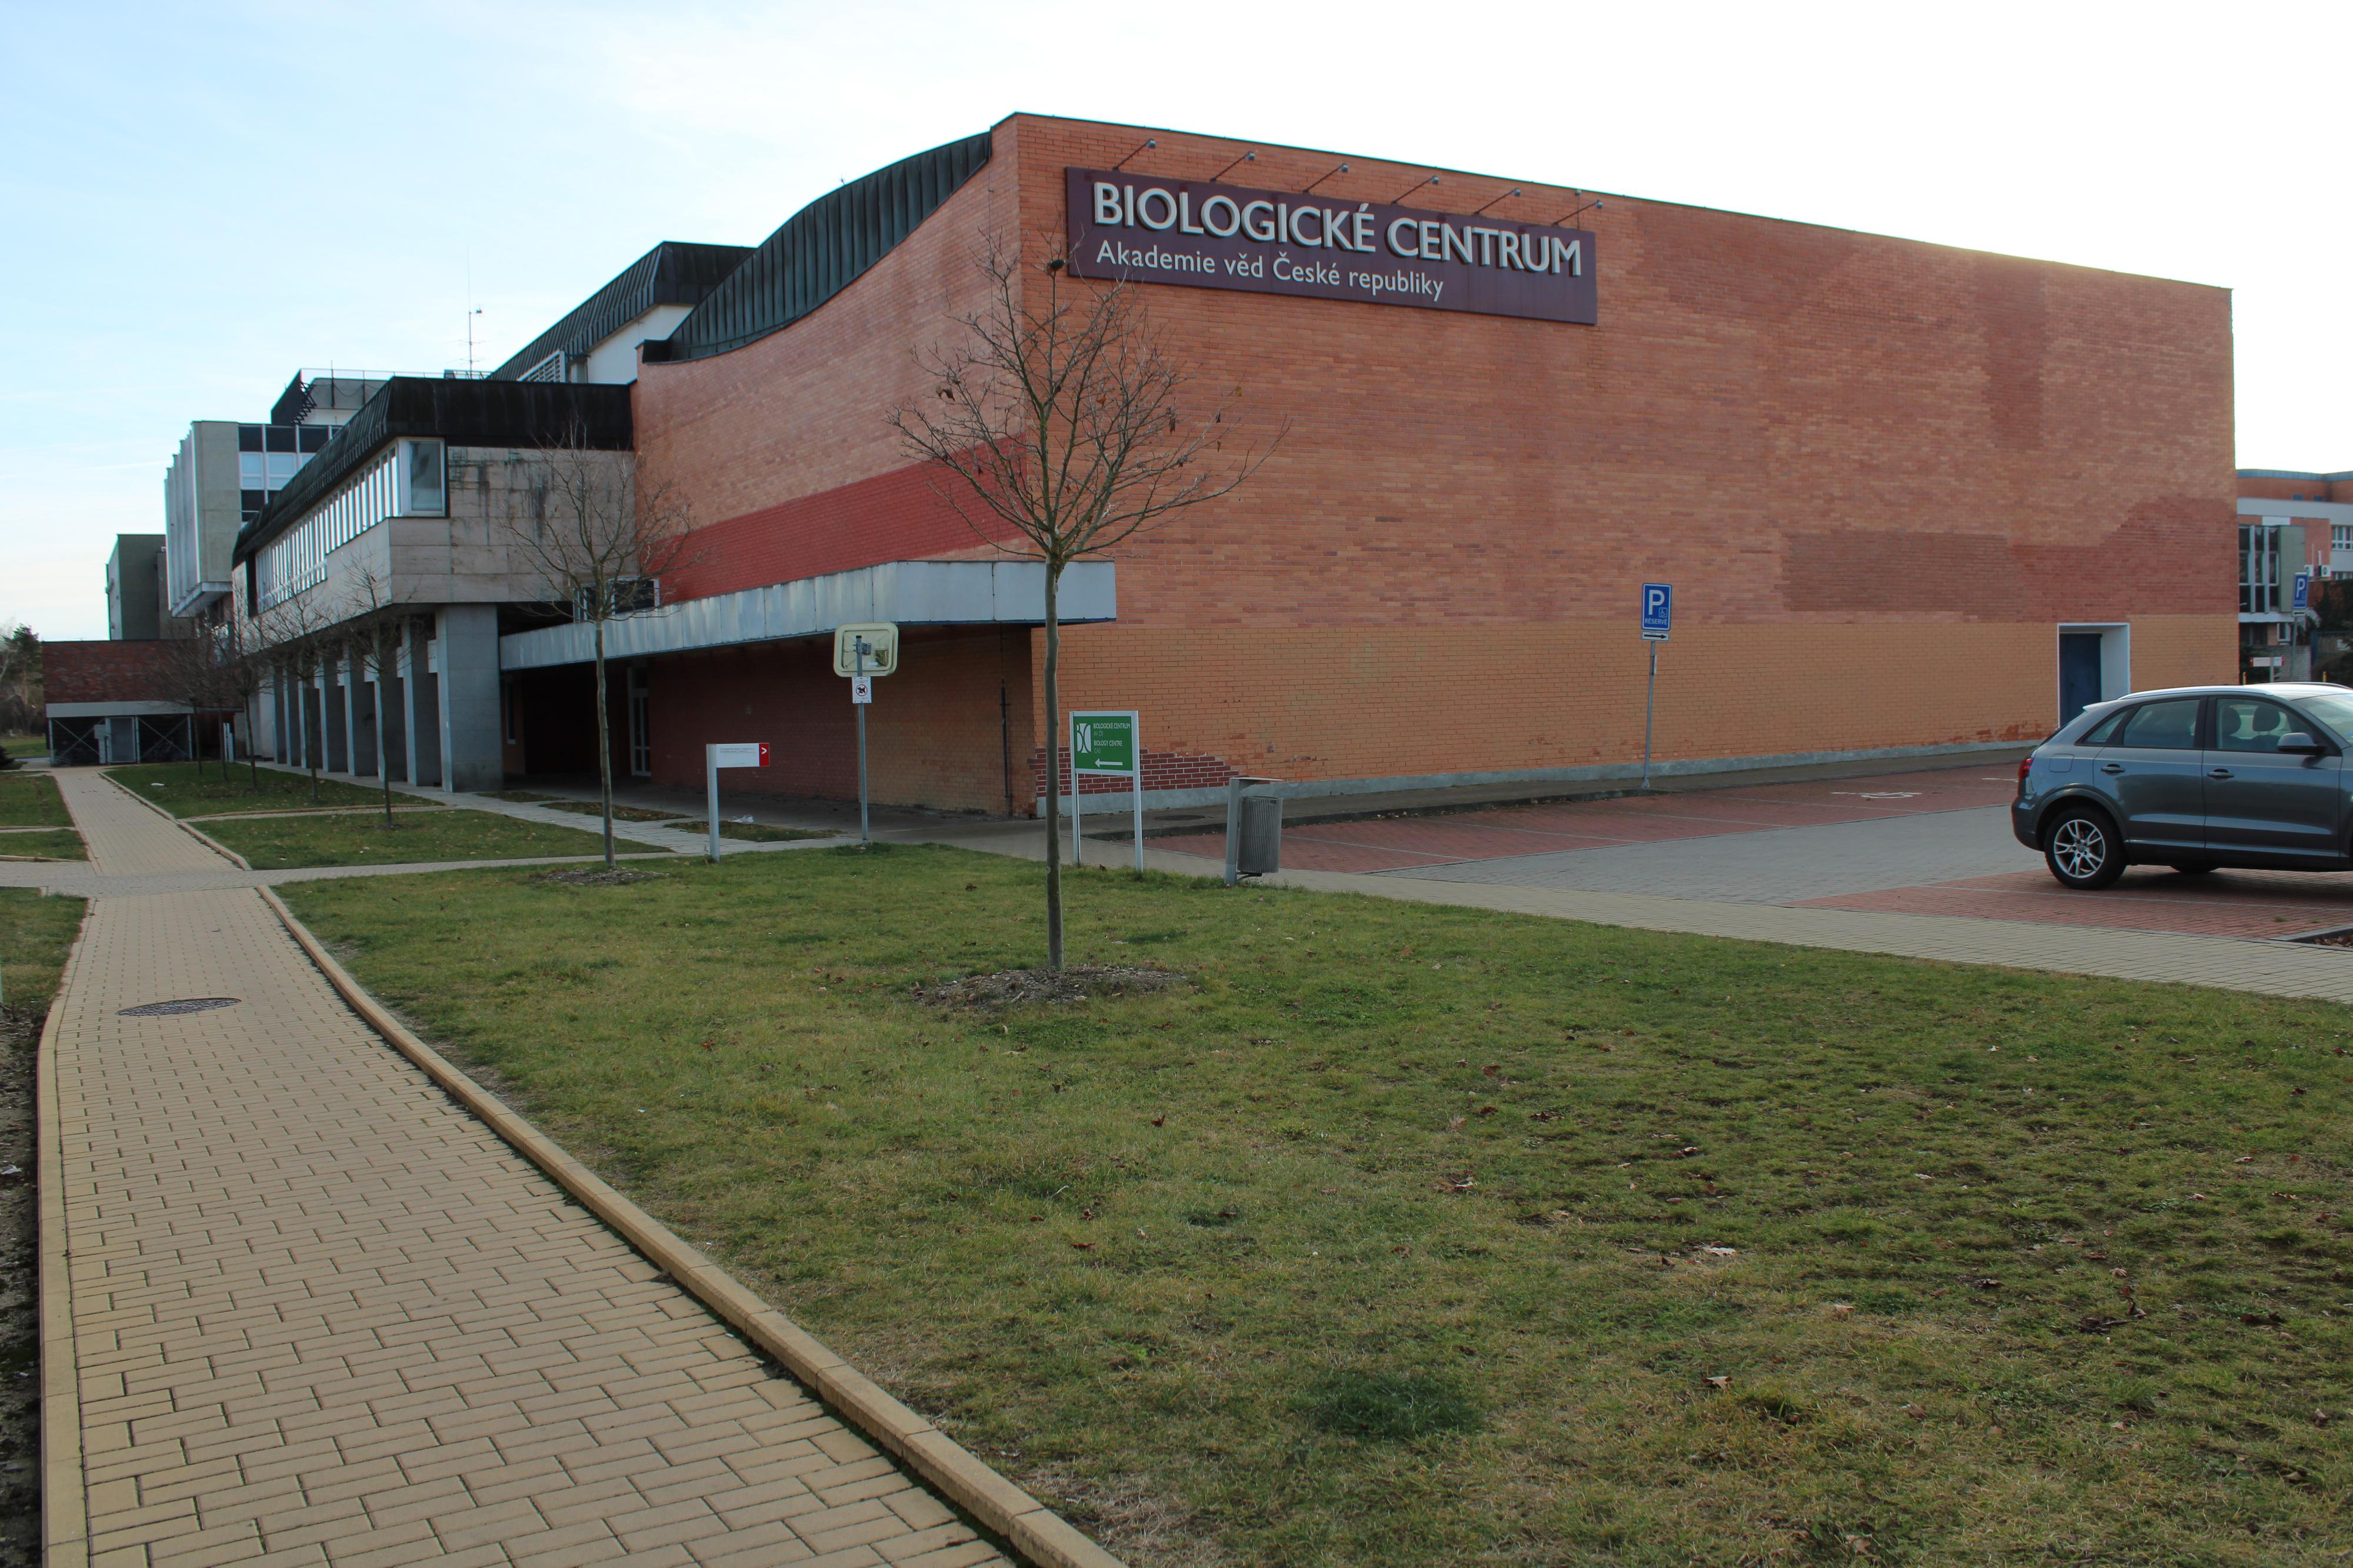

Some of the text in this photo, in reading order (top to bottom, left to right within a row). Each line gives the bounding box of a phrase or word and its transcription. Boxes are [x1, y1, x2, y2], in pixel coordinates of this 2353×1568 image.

[1094, 181, 1582, 276] BIOLOGICKÉ CENTRUM
[1096, 239, 1444, 302] Akademie věd České republiky
[1648, 589, 1665, 615] P
[2296, 578, 2305, 598] P
